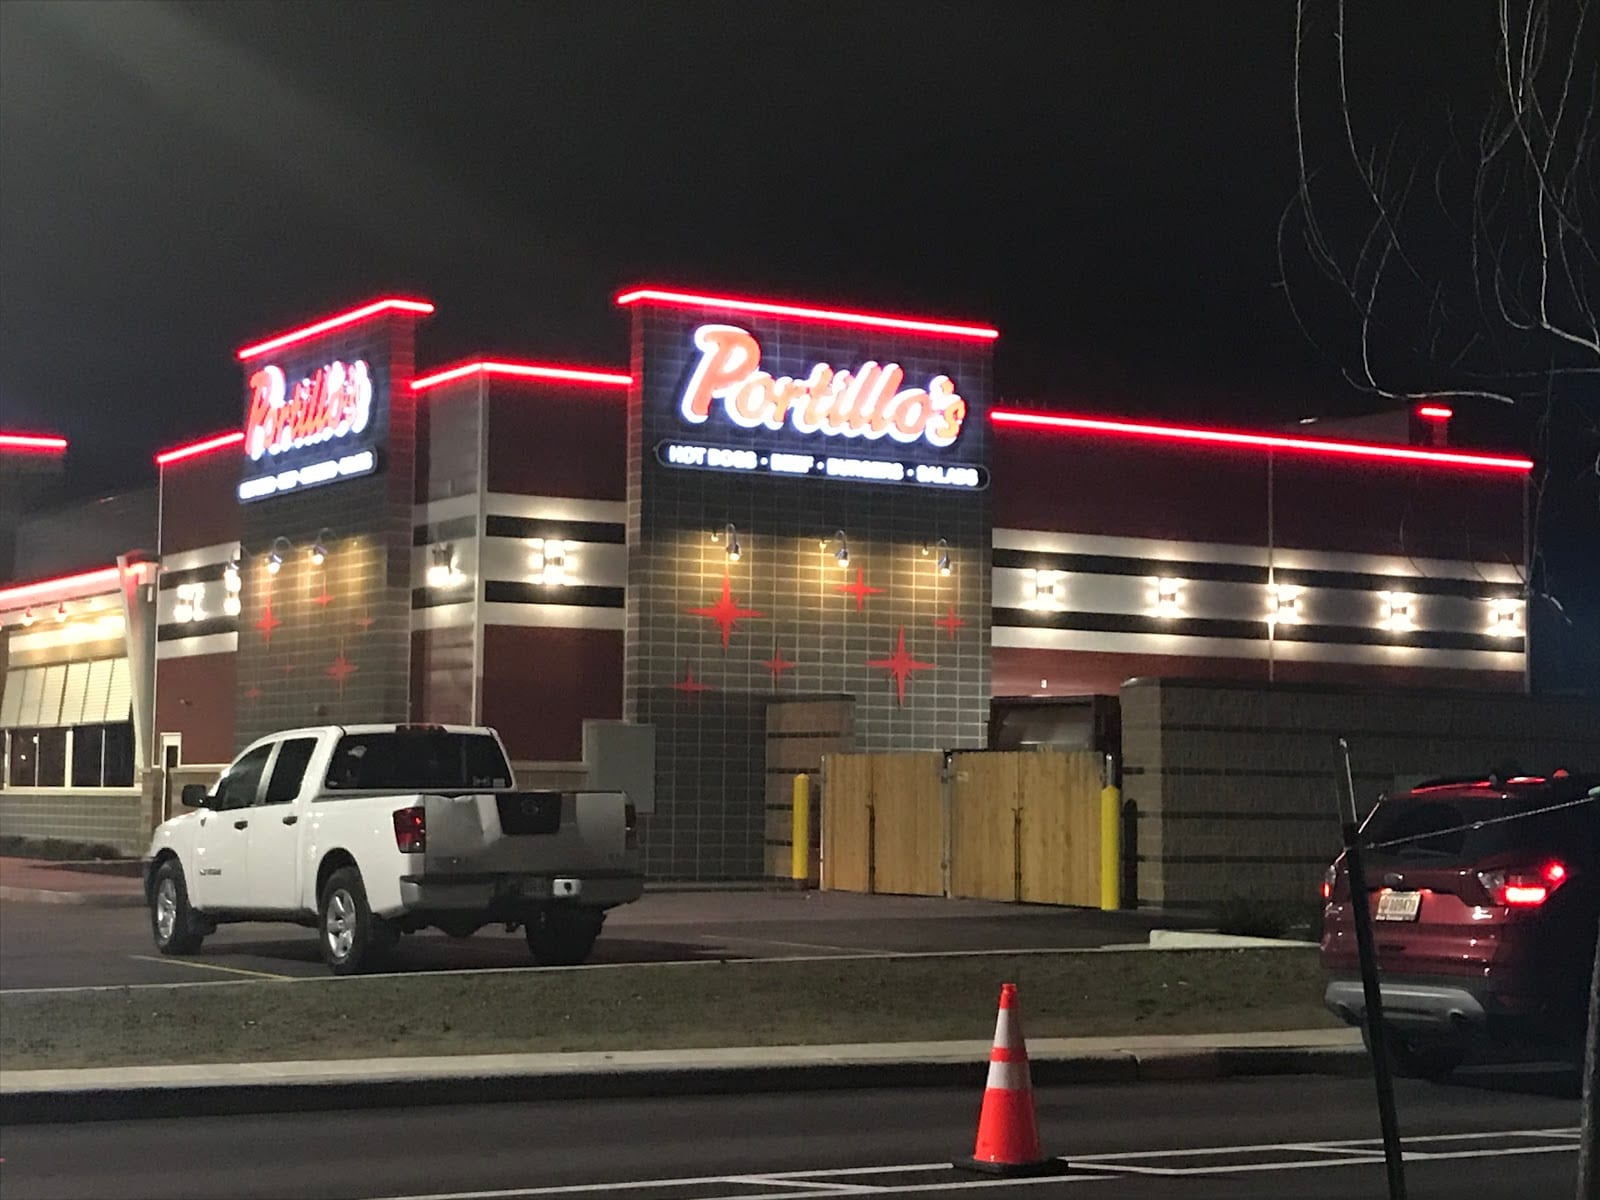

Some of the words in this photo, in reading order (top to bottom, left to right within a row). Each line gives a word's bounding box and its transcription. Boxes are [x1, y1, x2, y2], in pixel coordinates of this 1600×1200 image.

[681, 325, 966, 447] Portillo's
[669, 445, 706, 464] HOT
[770, 454, 814, 473] BF
